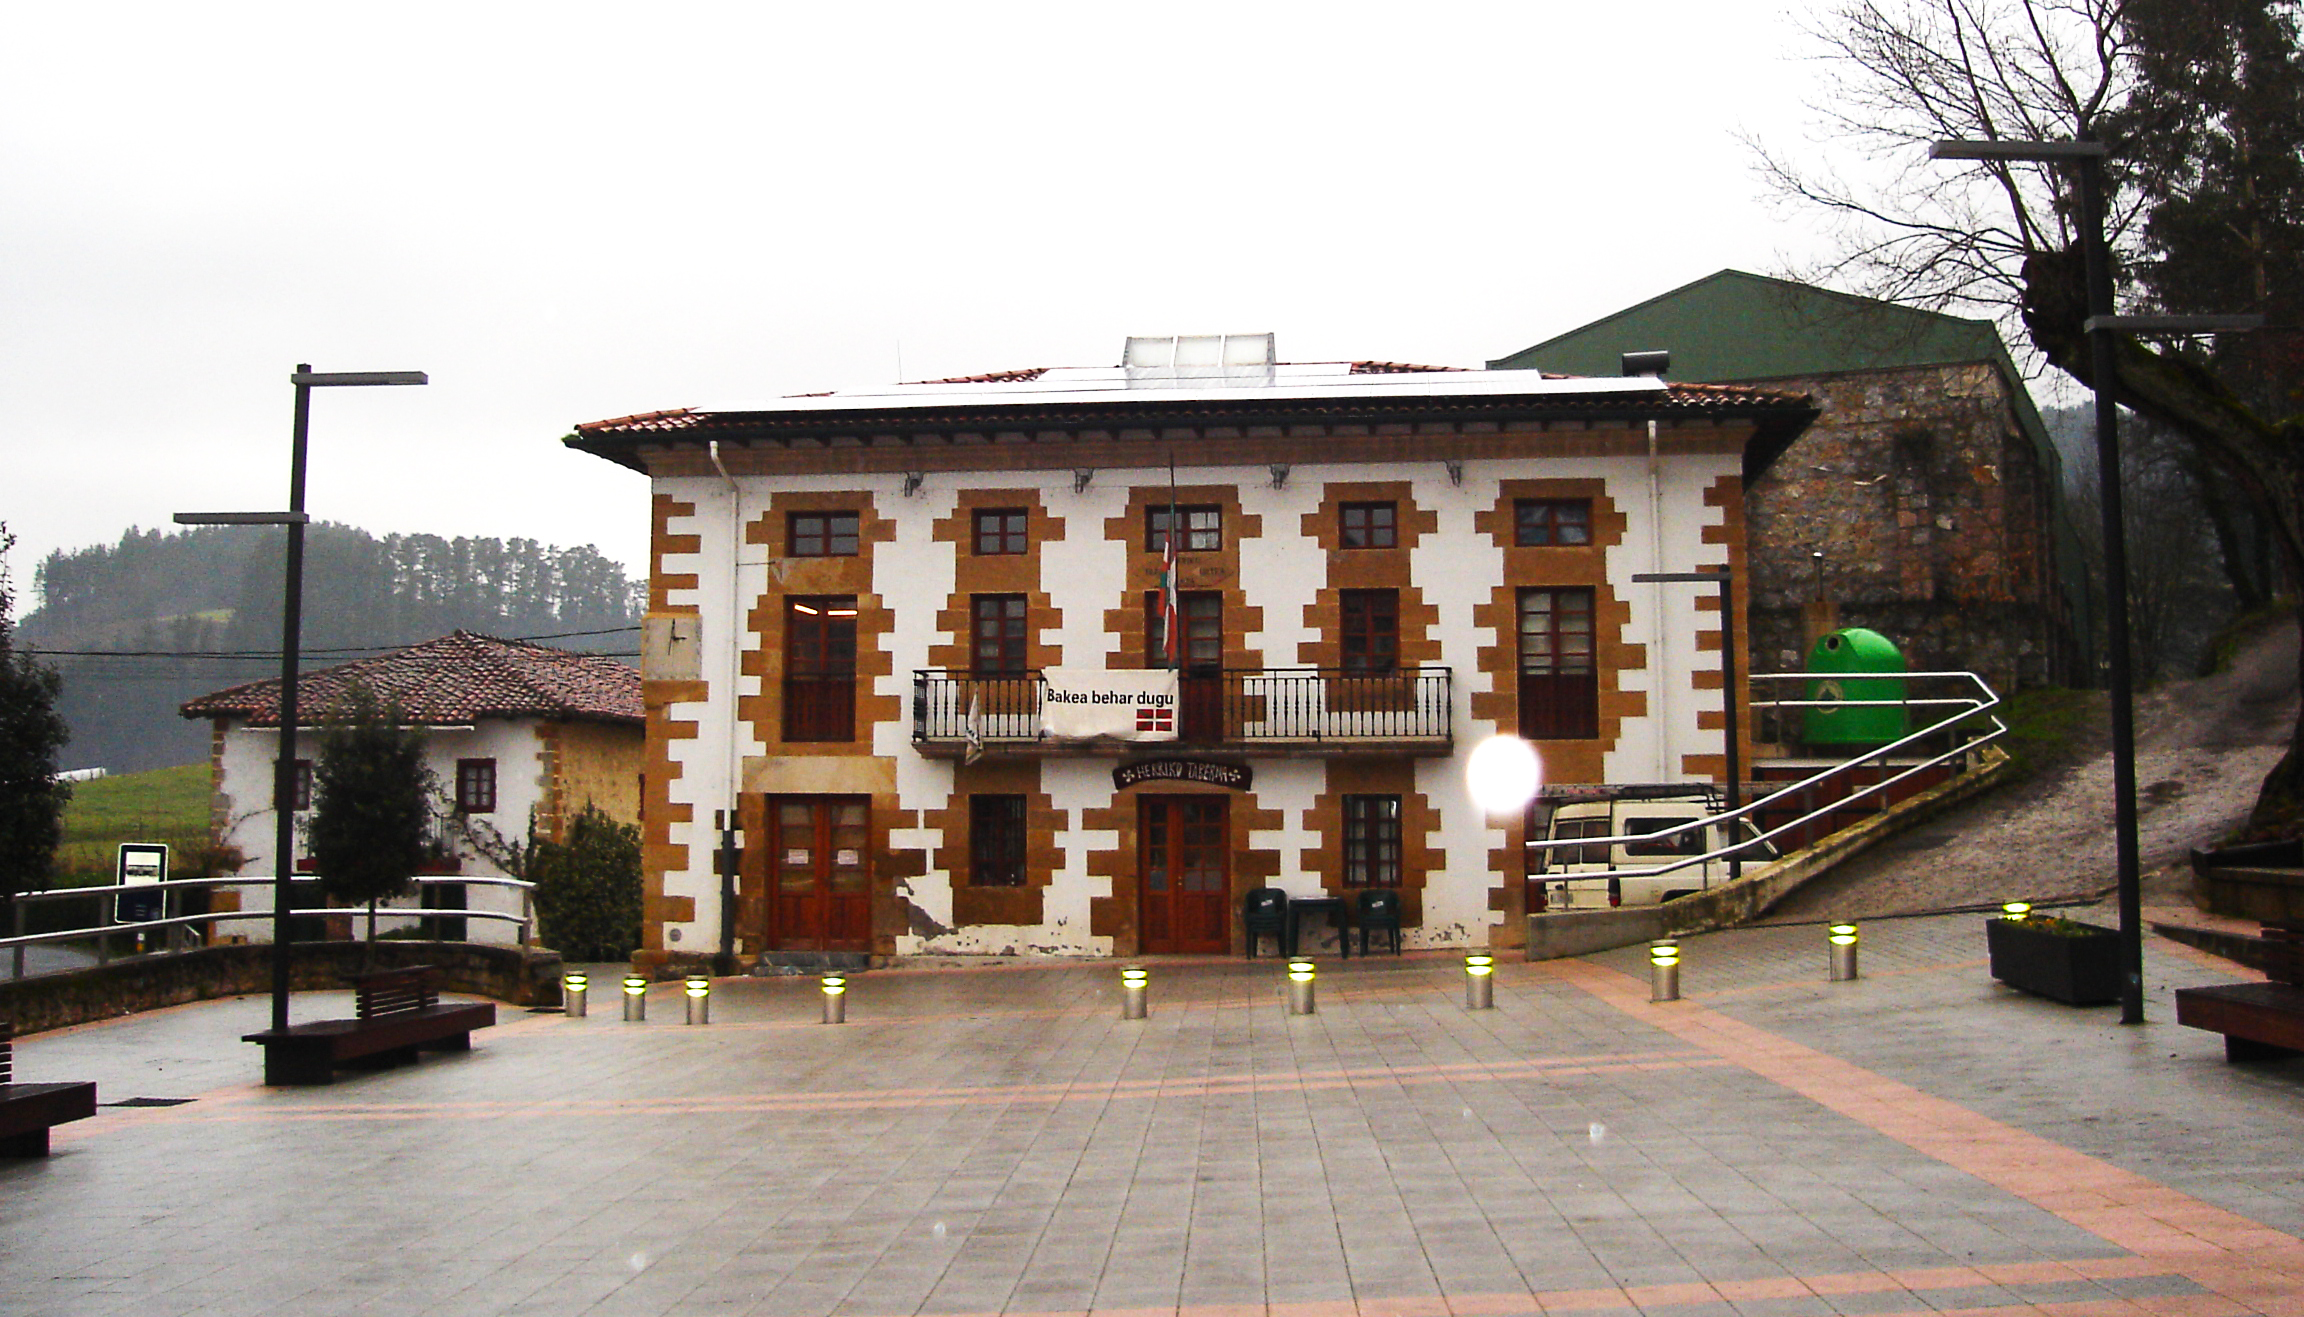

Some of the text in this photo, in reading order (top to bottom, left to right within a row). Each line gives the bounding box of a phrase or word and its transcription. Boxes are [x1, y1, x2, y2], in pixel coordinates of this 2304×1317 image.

[1047, 688, 1174, 708] Bakea behar dugu
[1136, 762, 1228, 782] HERRIKO TABERNA
